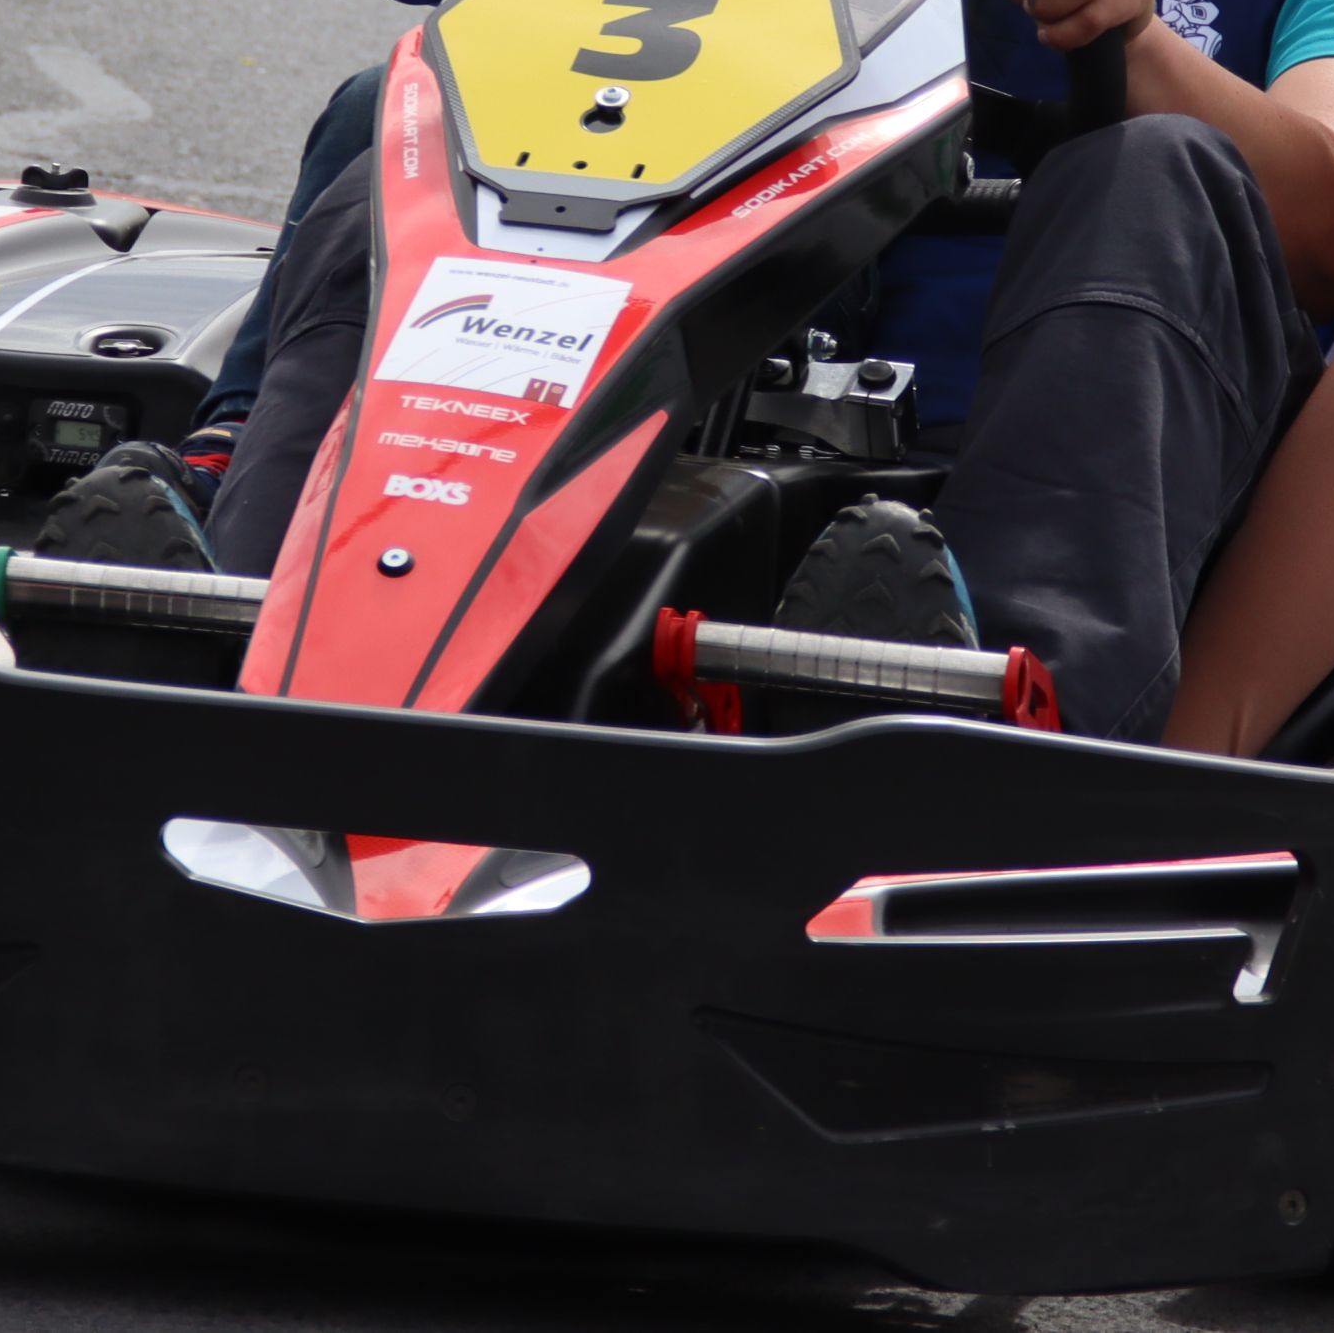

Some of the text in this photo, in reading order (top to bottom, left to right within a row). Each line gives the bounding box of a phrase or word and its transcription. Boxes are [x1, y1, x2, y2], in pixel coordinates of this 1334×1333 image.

[462, 316, 594, 352] Wenzel
[47, 401, 95, 419] MOTO
[401, 395, 531, 426] TEKNEEX
[47, 448, 101, 466] TIMER
